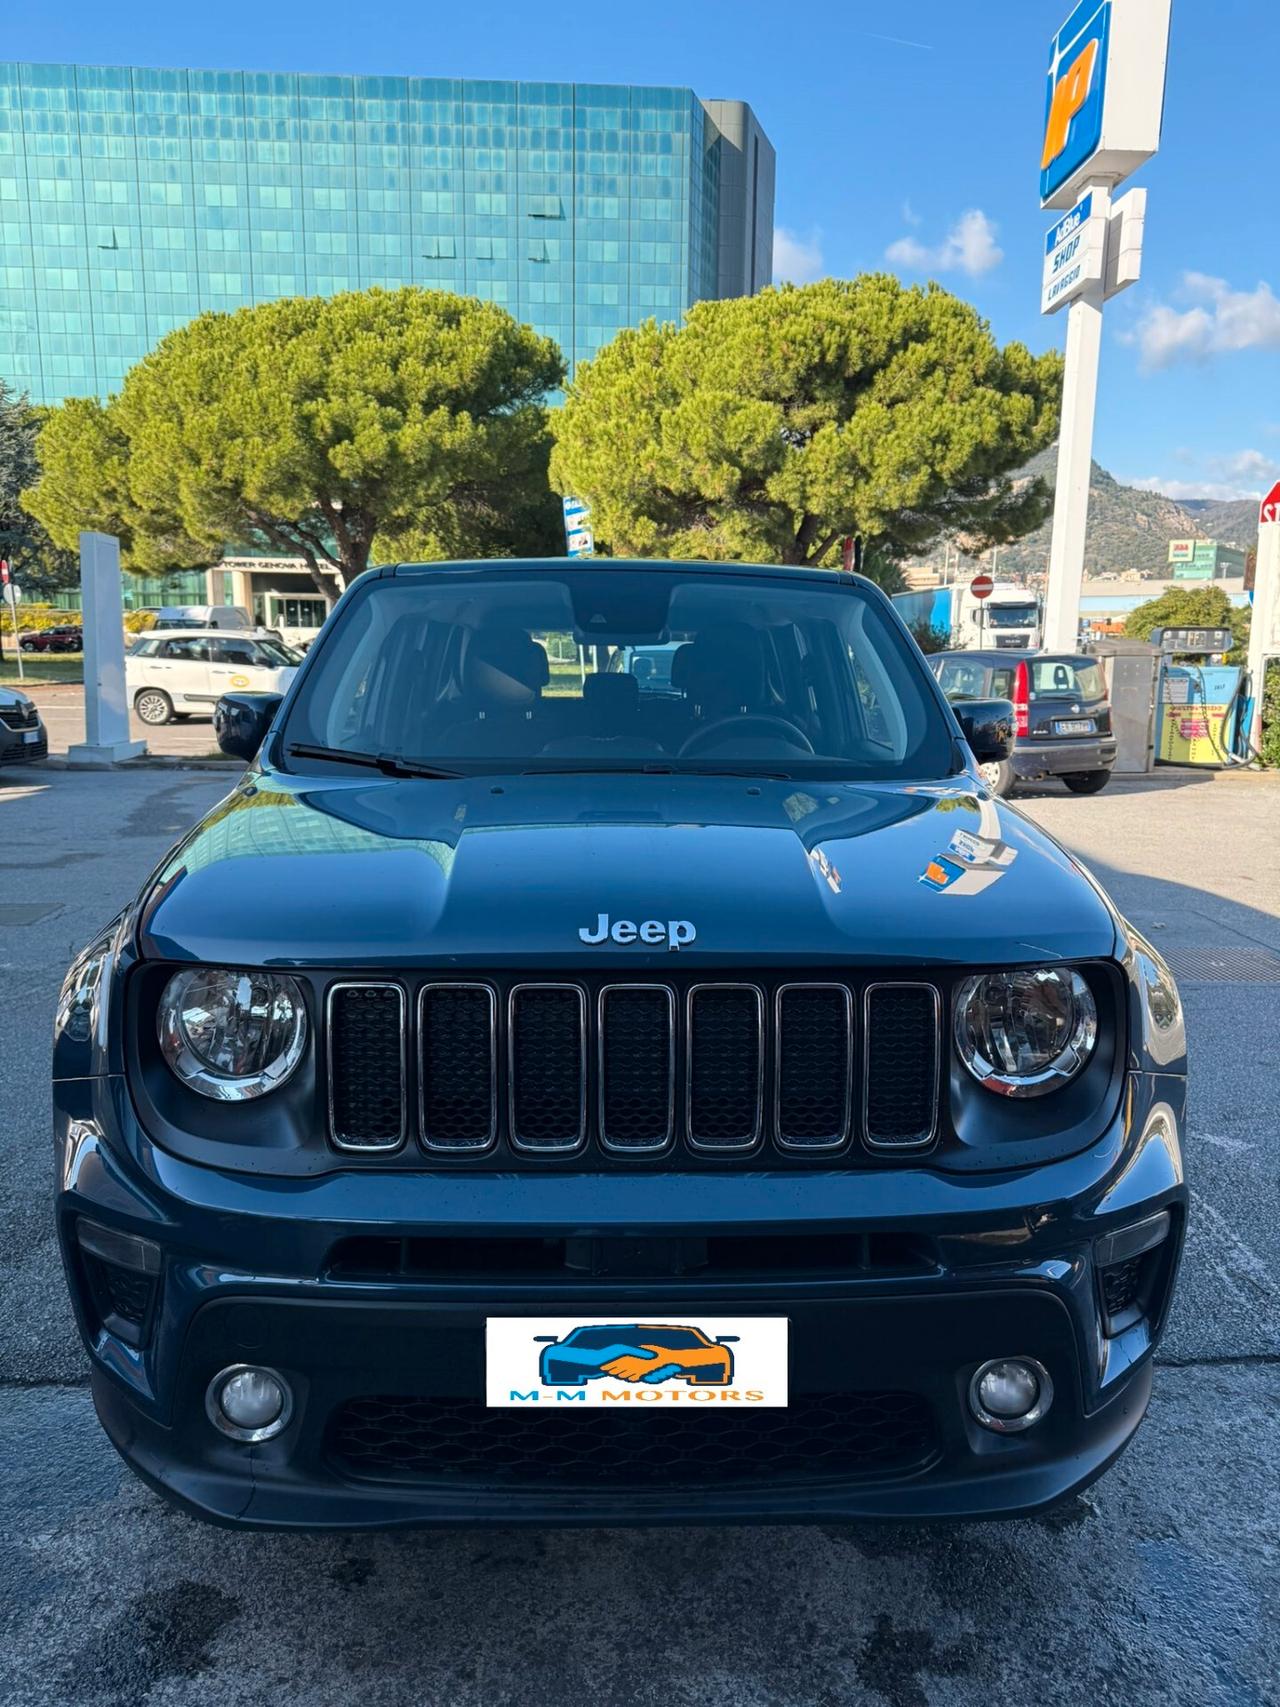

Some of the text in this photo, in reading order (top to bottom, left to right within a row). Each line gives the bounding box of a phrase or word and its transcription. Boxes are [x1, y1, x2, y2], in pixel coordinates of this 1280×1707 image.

[1054, 211, 1081, 247] AdBlue
[1052, 234, 1081, 274] SHOP
[1047, 264, 1081, 301] LAVAGGIO
[258, 561, 297, 569] GENOVA
[578, 913, 697, 951] Jeep
